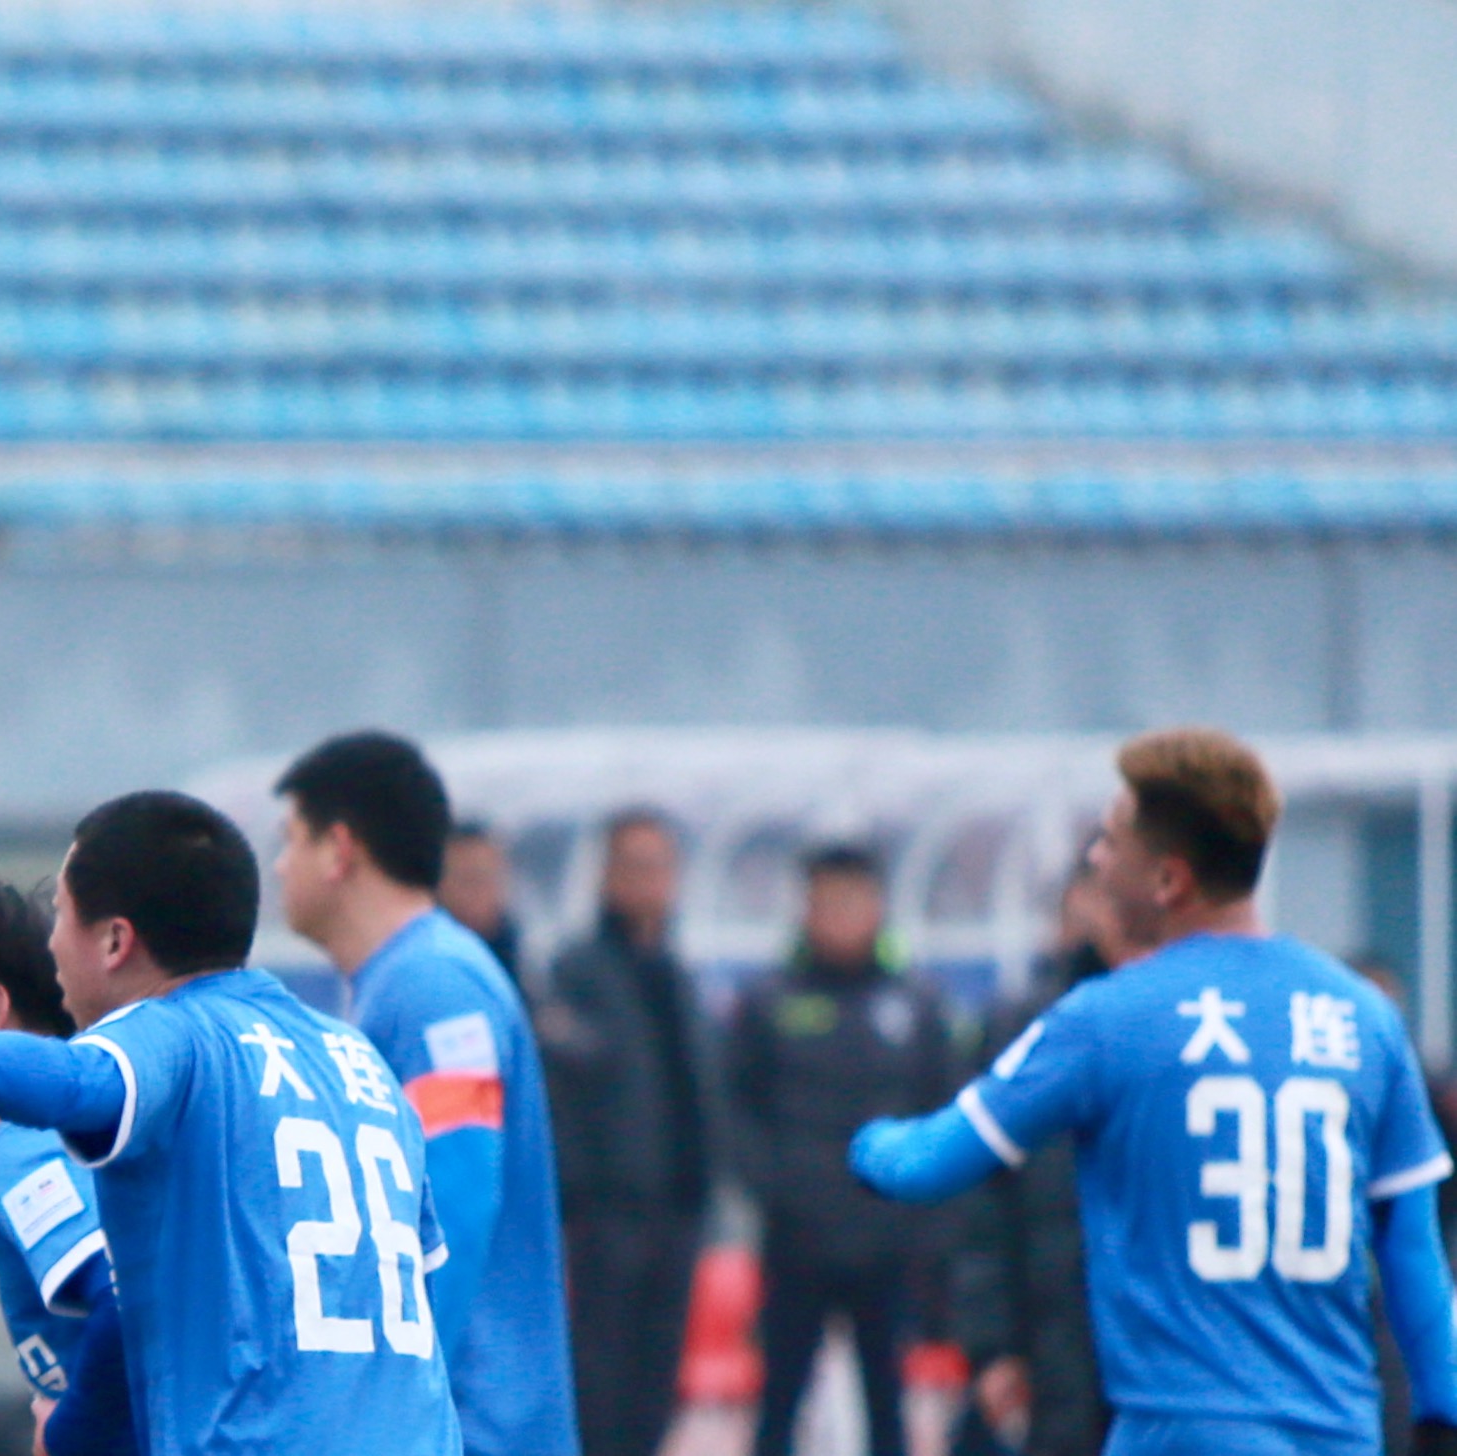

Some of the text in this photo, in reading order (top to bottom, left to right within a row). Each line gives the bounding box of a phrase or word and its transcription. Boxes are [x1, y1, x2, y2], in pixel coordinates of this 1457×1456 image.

[239, 1023, 398, 1116] 大连
[1176, 987, 1362, 1071] 大连
[274, 1116, 434, 1360] 26
[1186, 1075, 1354, 1282] 30
